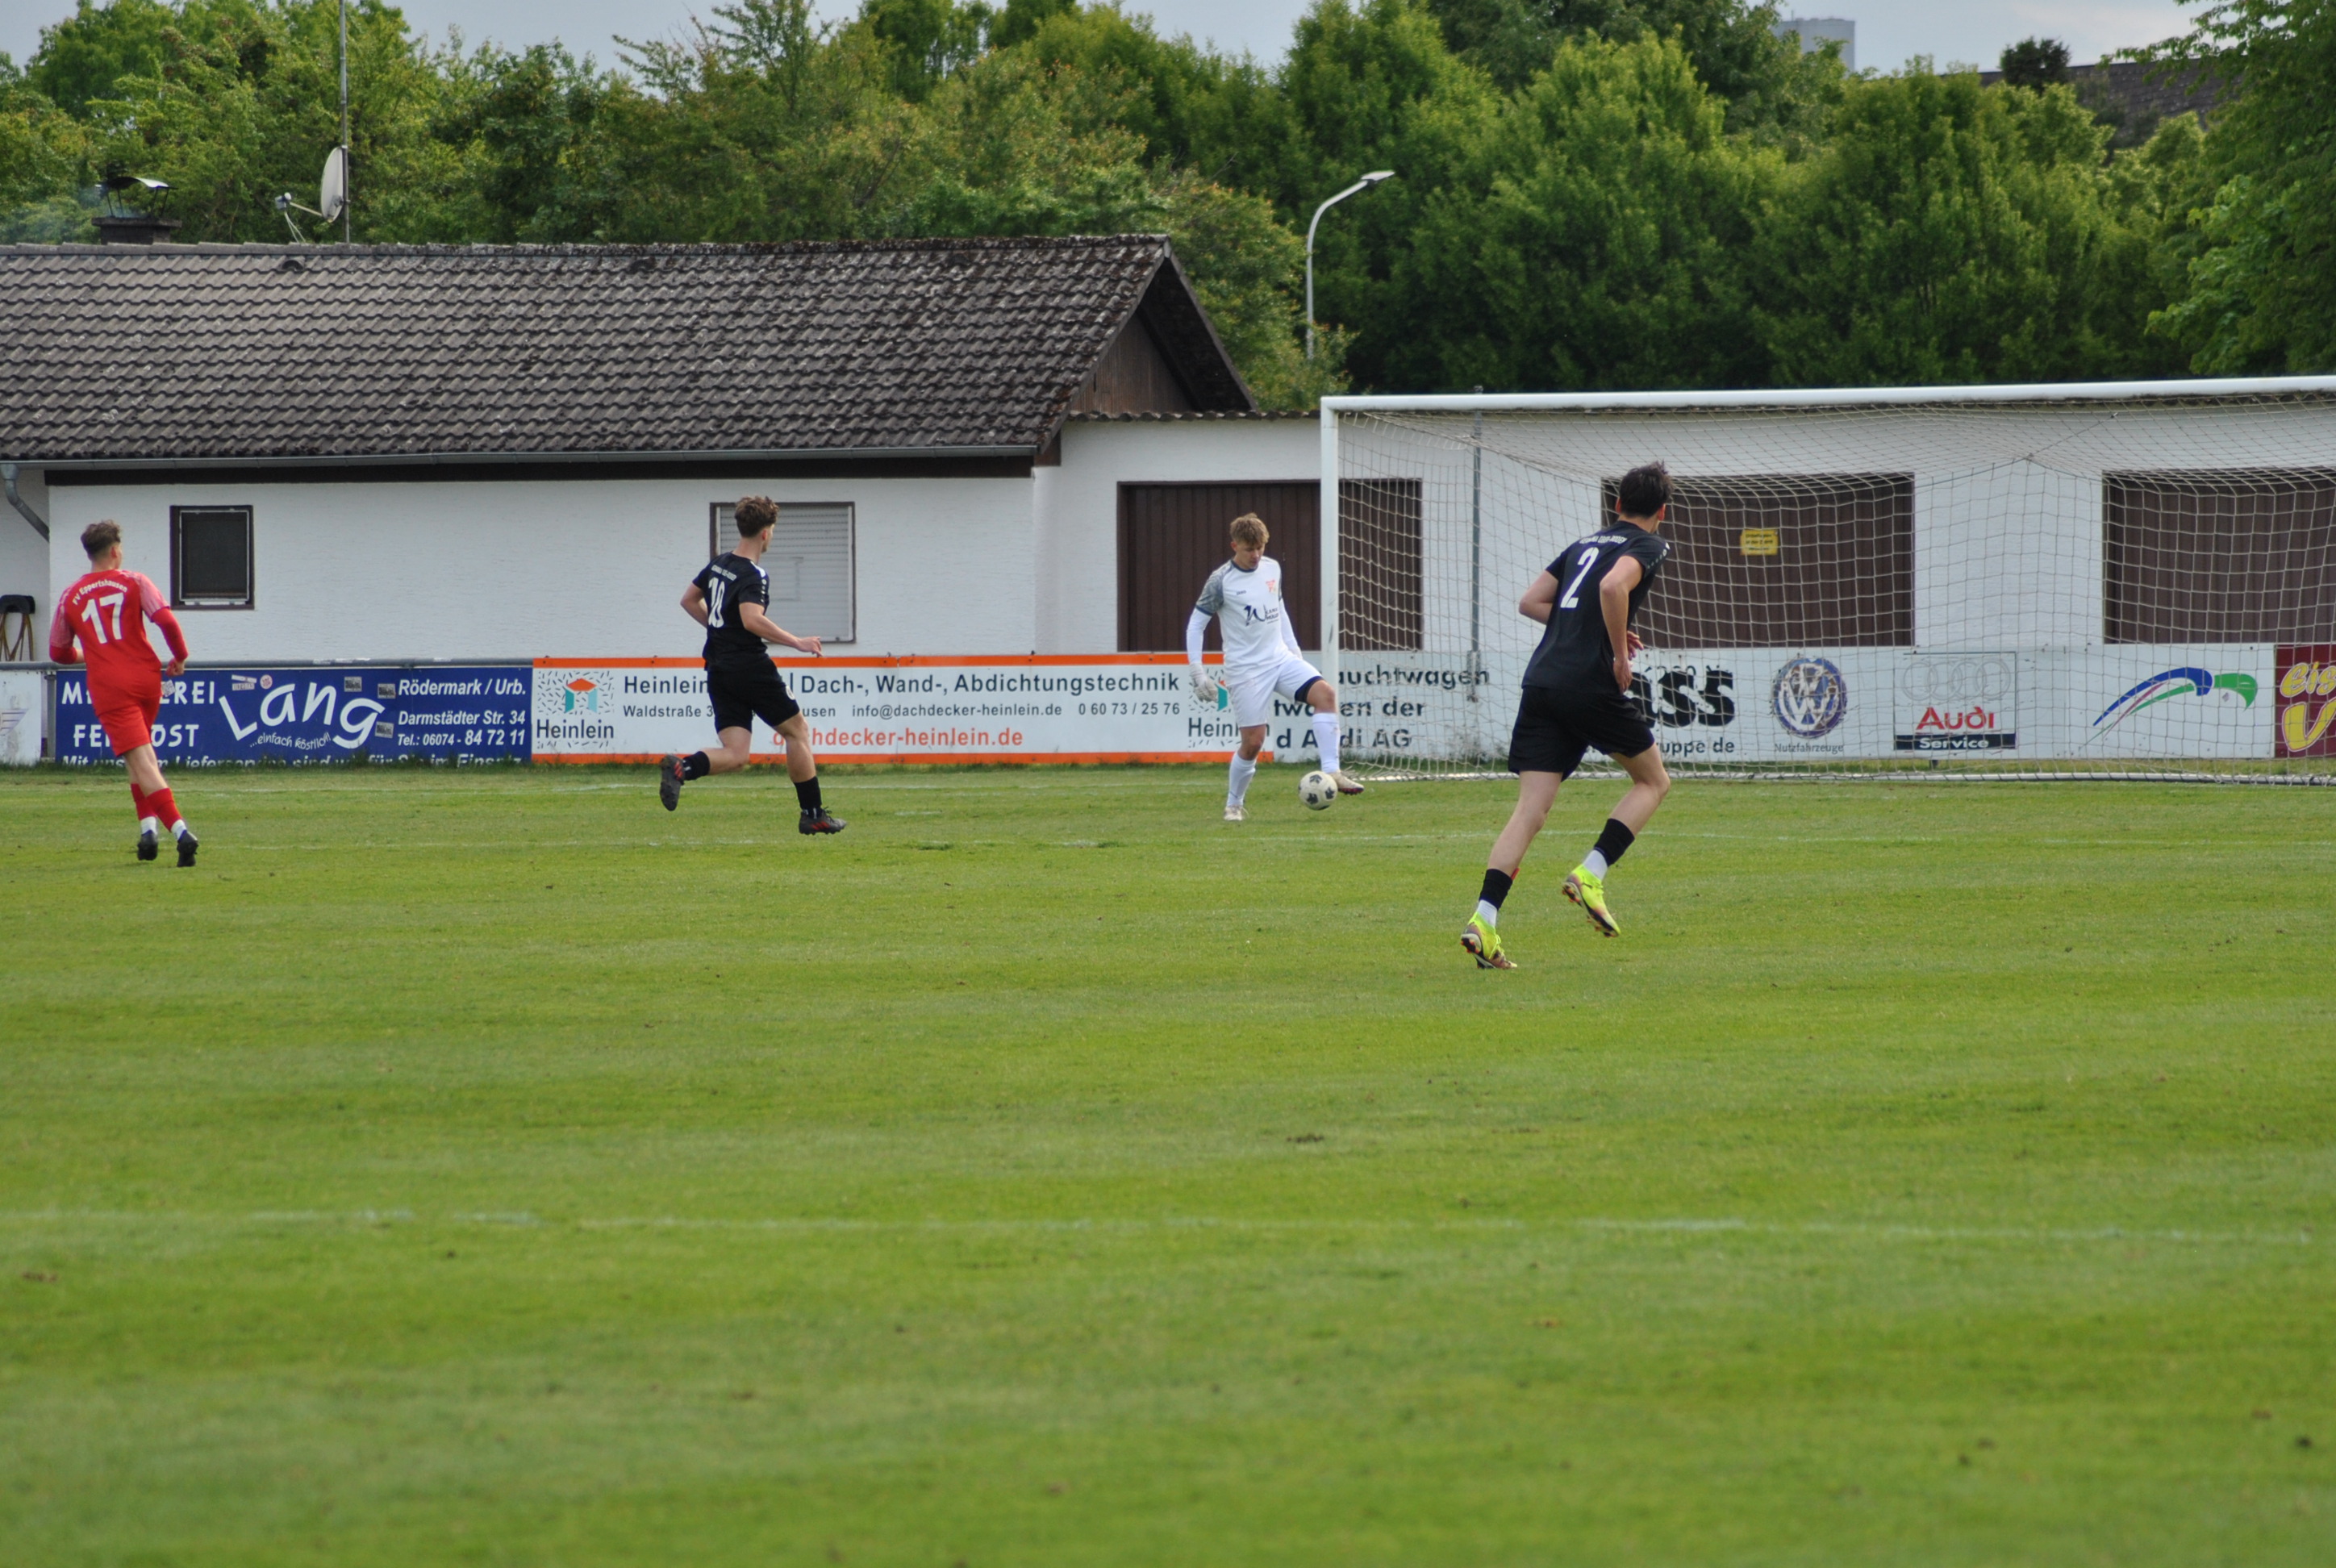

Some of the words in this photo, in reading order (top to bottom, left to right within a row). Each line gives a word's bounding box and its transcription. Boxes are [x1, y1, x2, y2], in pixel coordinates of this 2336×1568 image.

[79, 578, 127, 595] Eppertshausen
[1560, 547, 1600, 608] 2
[81, 592, 124, 644] 17
[398, 678, 482, 695] Rödermark
[495, 678, 526, 695] Urb.
[802, 675, 869, 696] Dach-,
[876, 674, 948, 696] Wand-,
[954, 673, 1179, 696] Abdichtungstechnik
[219, 682, 386, 749] Lang
[624, 706, 701, 717] Waldstraße
[852, 704, 1062, 719] info@dachdecker-heinlein.de
[1078, 703, 1086, 715] 0
[1091, 703, 1107, 715] 60
[1112, 703, 1128, 715] 73
[1141, 703, 1158, 715] 25
[1163, 703, 1180, 715] 76
[1383, 696, 1425, 717] der
[398, 710, 481, 725] Darmstädter
[483, 710, 505, 725] Str.
[509, 710, 526, 725] 34
[1915, 706, 1994, 730] Audi
[398, 733, 420, 746] Tel.:
[423, 733, 454, 746] 06074
[465, 729, 482, 746] 84
[487, 729, 505, 746] 72
[510, 729, 526, 746] 11
[536, 719, 614, 738] Heinlein
[1373, 728, 1412, 749] AG
[1919, 736, 1989, 749] Service
[1774, 743, 1844, 755] Nutzfahrzeuge
